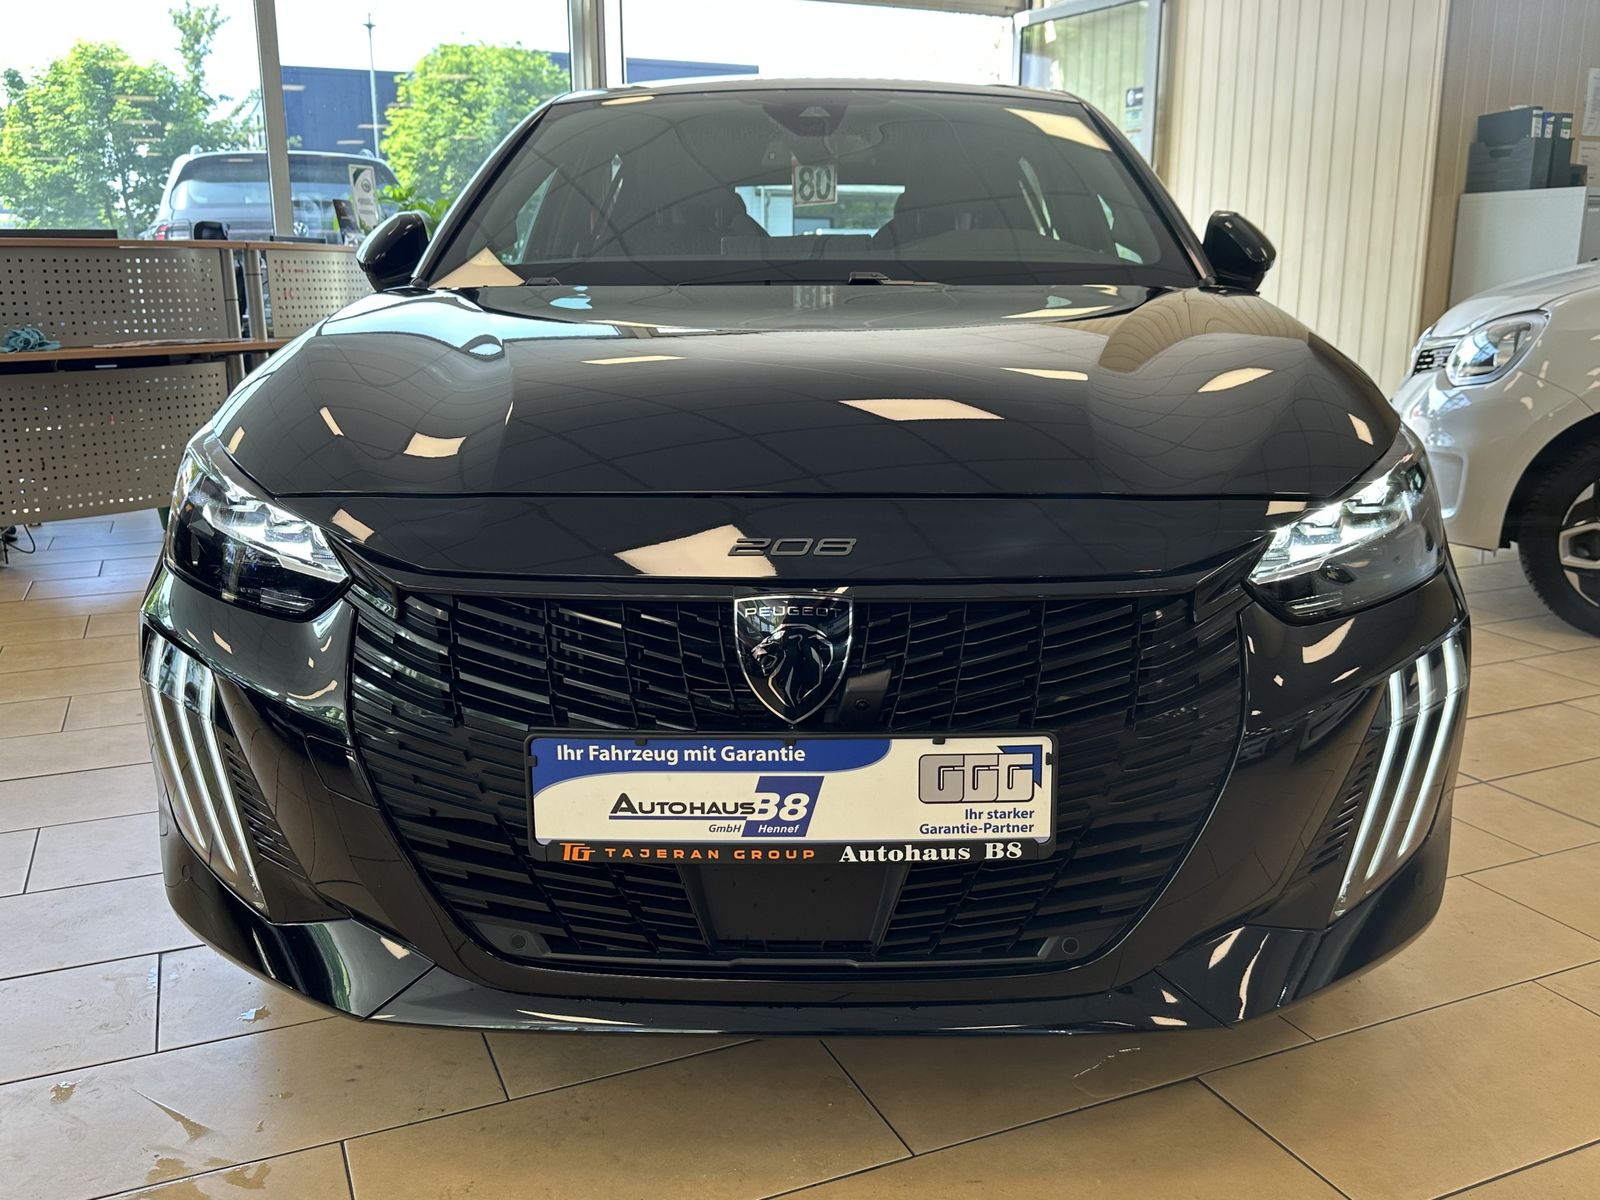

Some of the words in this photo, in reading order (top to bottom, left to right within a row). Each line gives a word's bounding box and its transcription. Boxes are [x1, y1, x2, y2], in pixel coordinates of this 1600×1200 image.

[798, 166, 832, 201] 80
[728, 538, 857, 556] 208
[744, 606, 842, 618] PEUGEOT
[557, 745, 584, 761] Ihr
[588, 745, 679, 765] Fahrzeug
[684, 746, 716, 761] mit
[720, 745, 806, 762] Garantie
[964, 809, 984, 820] Ihr
[987, 808, 1035, 819] starker
[708, 823, 742, 833] GmbH
[758, 823, 799, 833] Hennef
[919, 822, 1035, 835] Garantie-Partner
[604, 848, 720, 859] TAJERAN
[733, 849, 816, 860] GROUP
[839, 845, 971, 863] Autohaus
[984, 842, 1023, 860] B8
